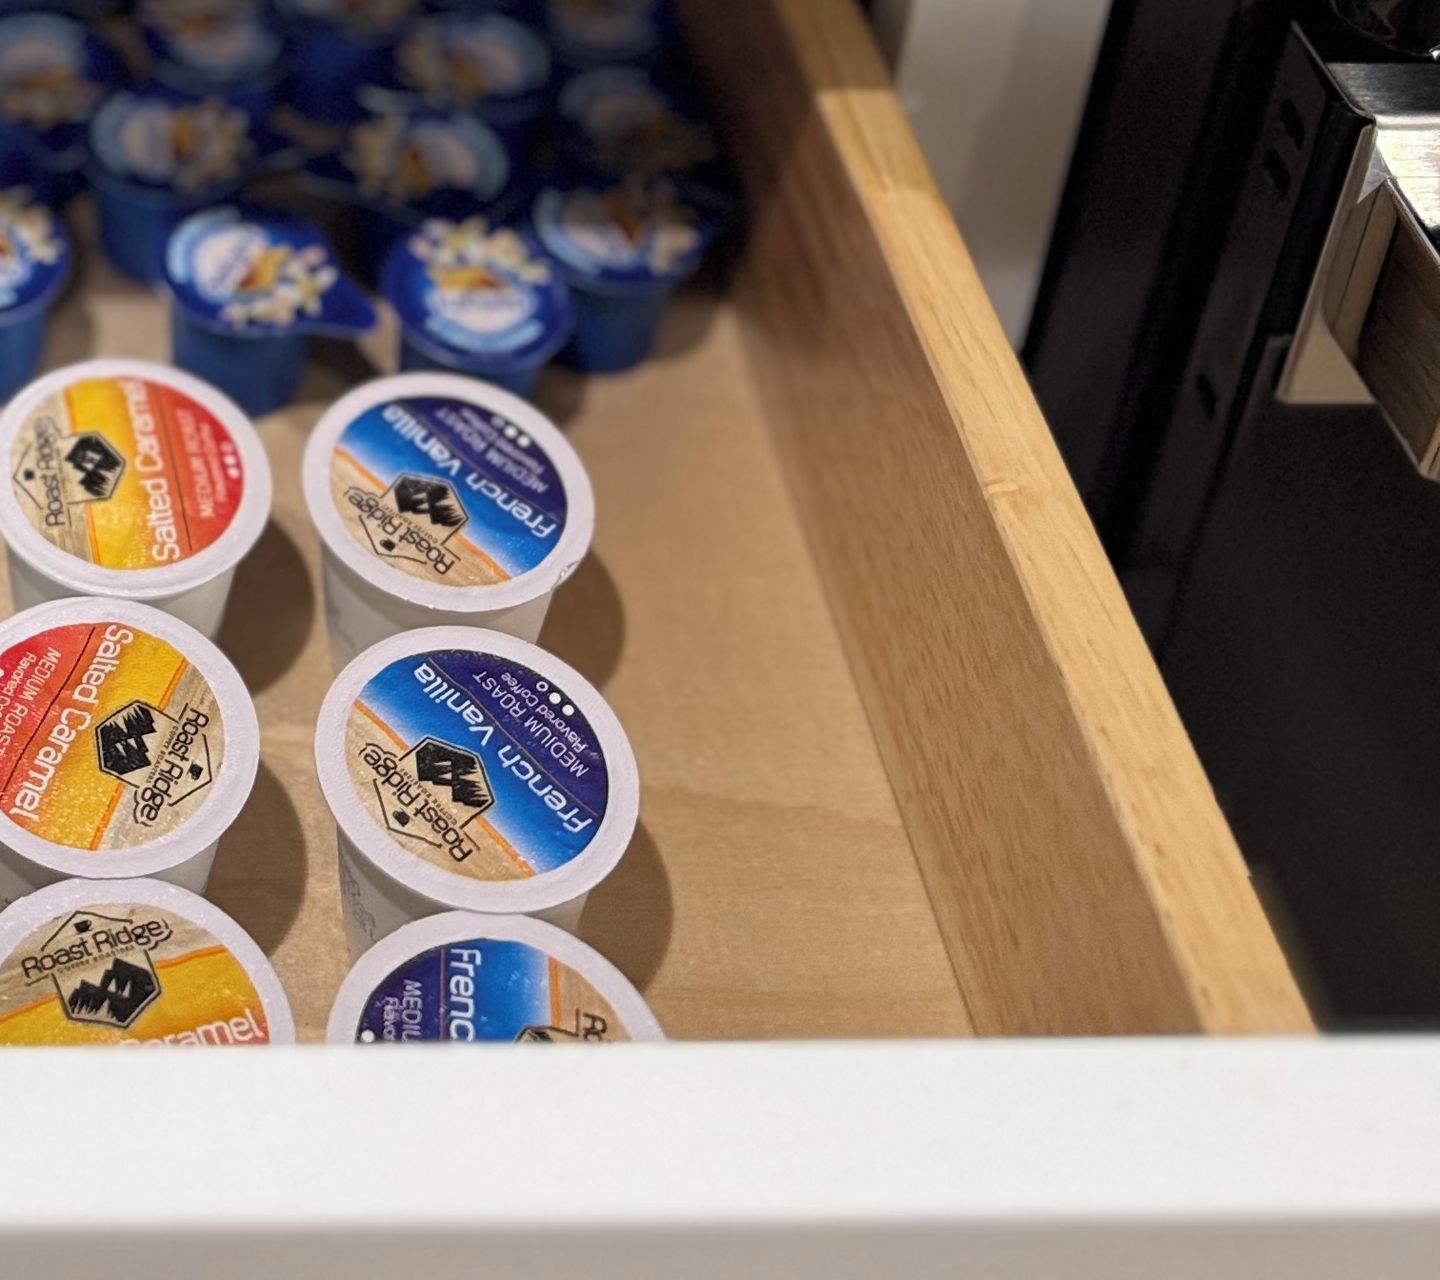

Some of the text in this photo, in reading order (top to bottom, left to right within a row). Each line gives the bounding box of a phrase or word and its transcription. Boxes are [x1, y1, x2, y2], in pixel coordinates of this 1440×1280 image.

[117, 380, 180, 562] Salted Caramel
[382, 403, 555, 540] French Vanilla
[435, 405, 547, 493] MEDIUM ROAST
[41, 471, 65, 527] Roast
[348, 491, 453, 574] Roast Ridge
[2, 651, 35, 697] Flavored
[21, 648, 60, 701] MEDIUM
[500, 672, 586, 751] Flavored Coffee
[9, 623, 132, 820] Salted Caramel
[140, 710, 208, 820] Roast Ridge
[413, 663, 591, 831] French Vanilla
[472, 670, 587, 776] MEDIUM ROAST
[362, 749, 472, 863] Roast Ridge
[22, 919, 163, 977] Roast Ridge
[449, 948, 481, 1042] Frenc
